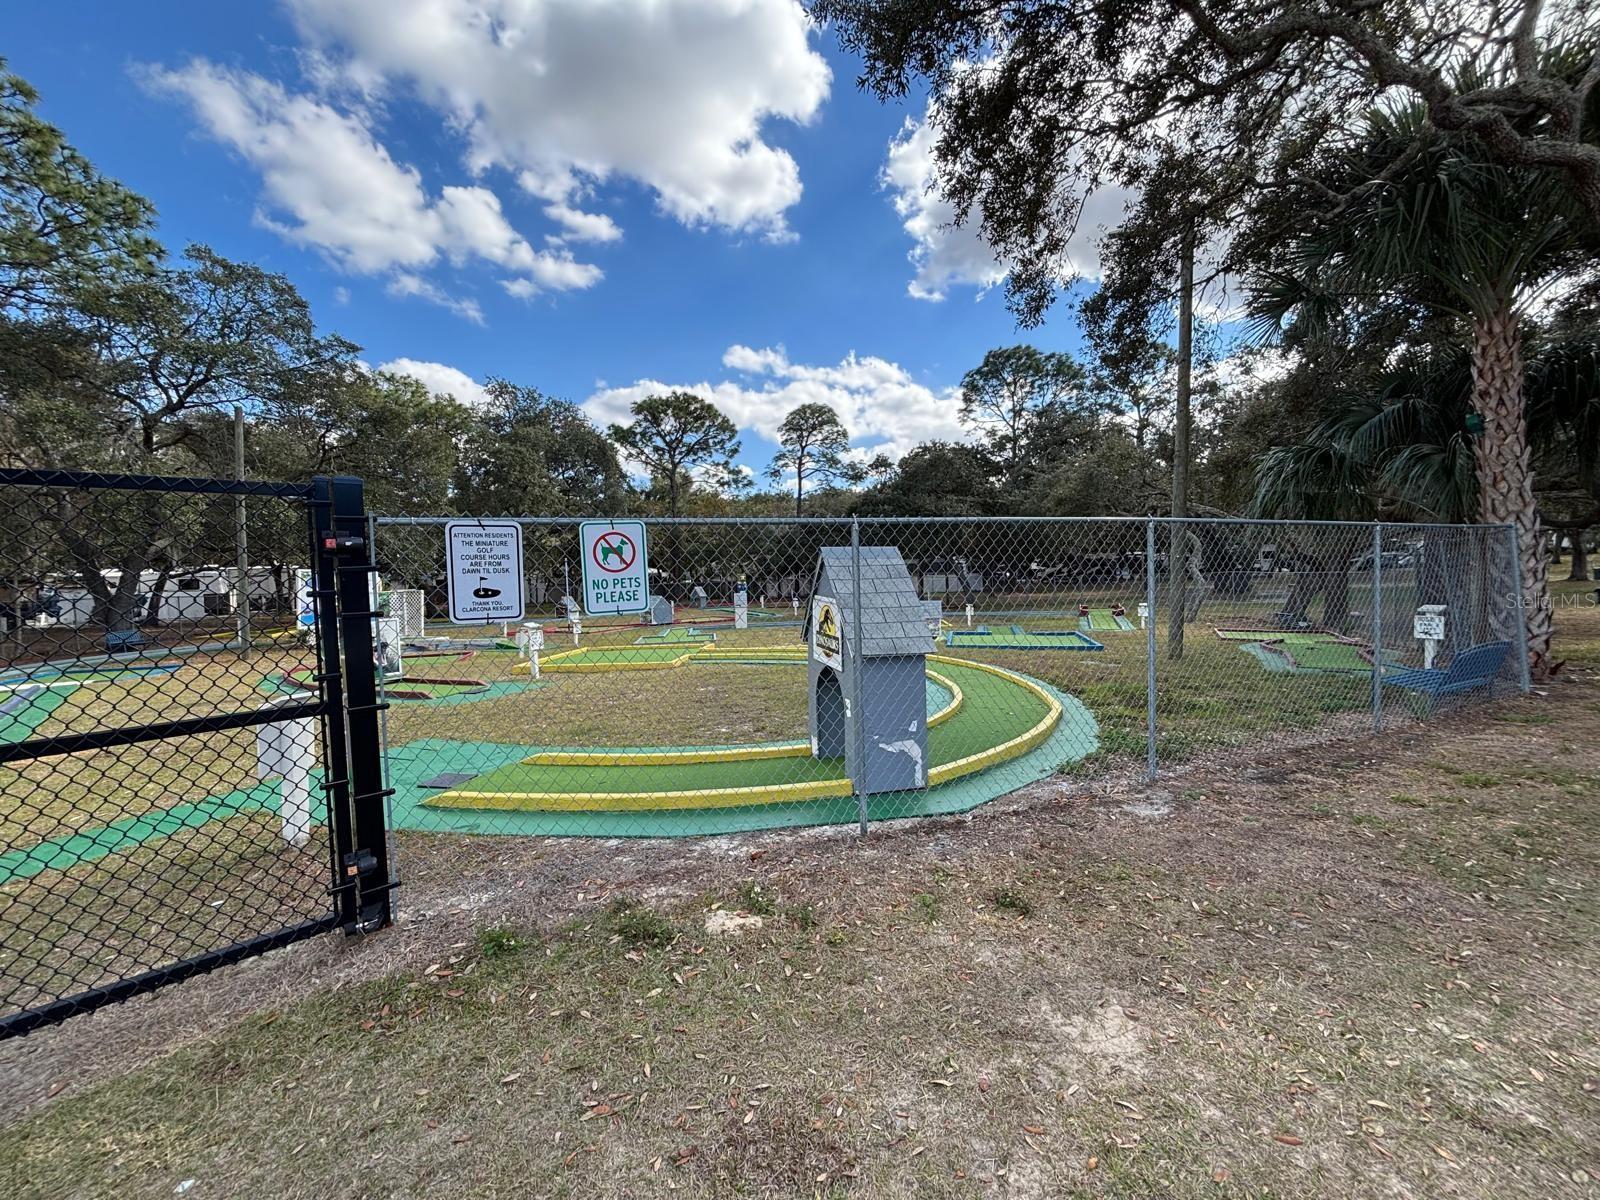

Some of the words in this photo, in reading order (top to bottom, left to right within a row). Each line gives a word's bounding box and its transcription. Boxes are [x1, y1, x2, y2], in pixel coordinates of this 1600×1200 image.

[592, 578, 609, 590] NO
[613, 577, 640, 588] PETS
[596, 590, 639, 603] PLEASE
